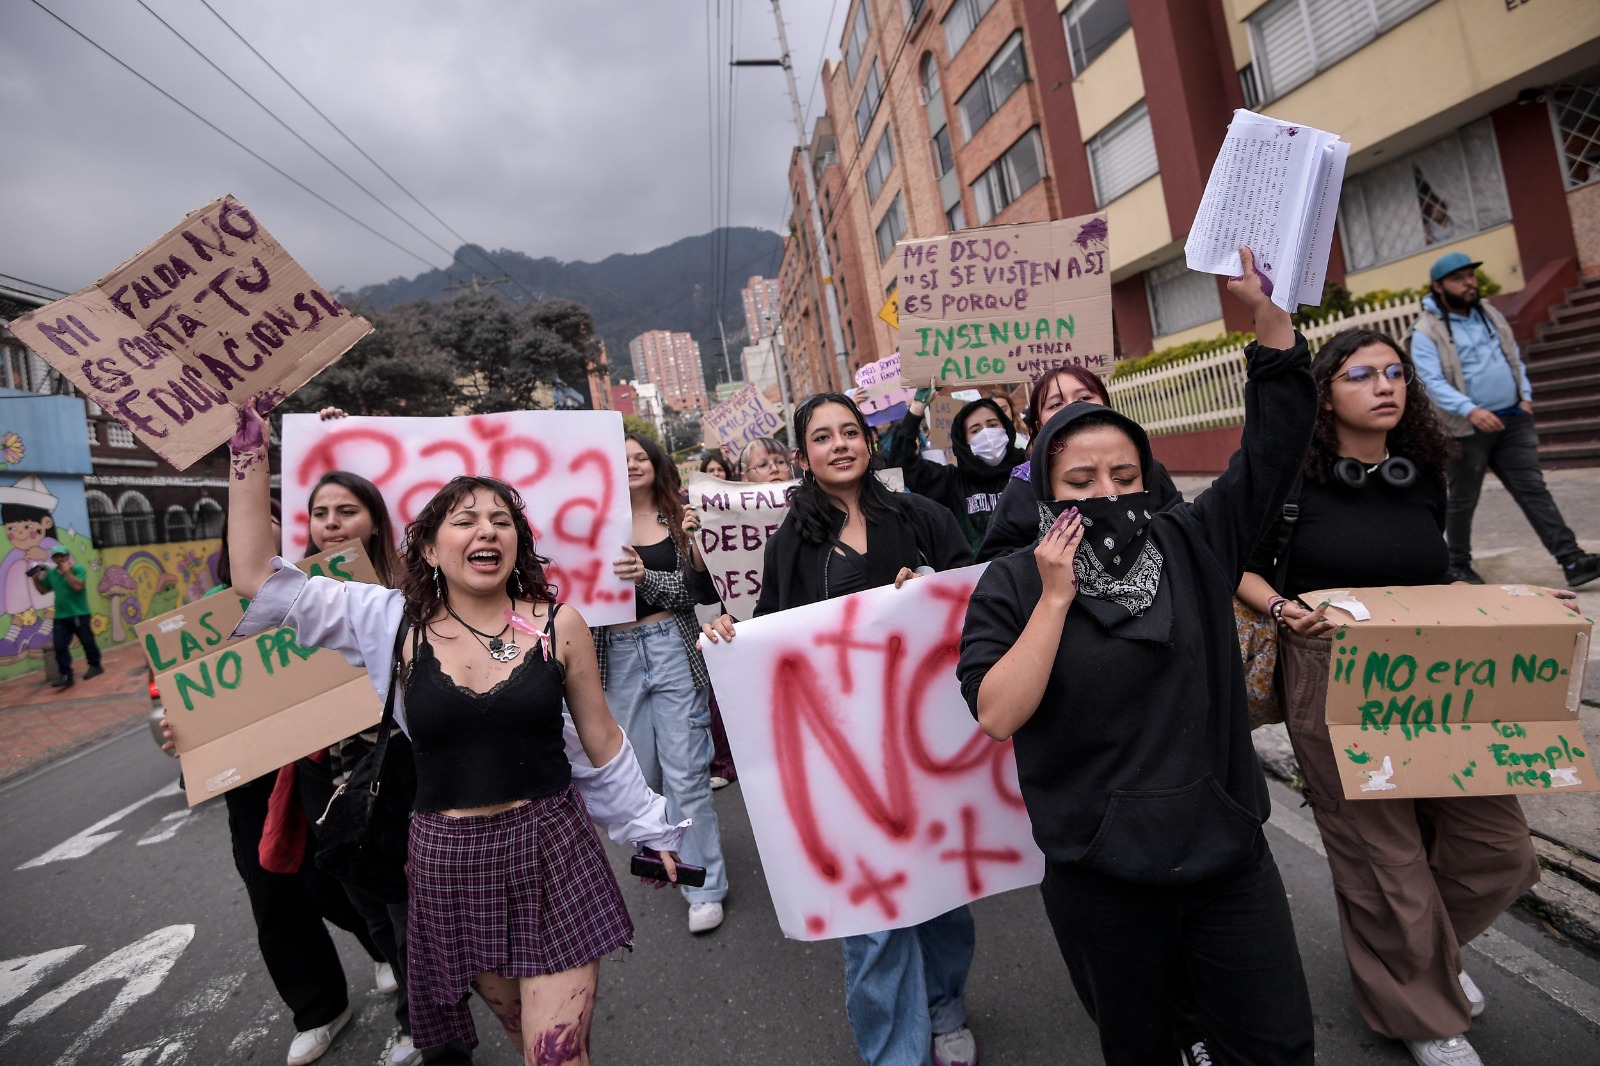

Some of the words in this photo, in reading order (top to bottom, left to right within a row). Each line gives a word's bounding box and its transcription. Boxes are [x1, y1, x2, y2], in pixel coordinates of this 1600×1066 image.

[904, 244, 938, 268] ME
[950, 234, 1020, 262] DIJO:
[38, 314, 100, 356] MI
[108, 254, 198, 319] FALDA
[181, 201, 260, 261] NO
[950, 264, 976, 288] SE
[983, 258, 1060, 287] VISTEN
[904, 294, 932, 314] ES
[82, 358, 134, 394] ES
[194, 256, 271, 316] TU
[914, 314, 1076, 357] INSINUAN
[742, 412, 778, 442] CREO
[145, 612, 222, 671] LAS
[174, 650, 242, 711] NO
[256, 628, 320, 675] PR
[1426, 658, 1496, 689] era
